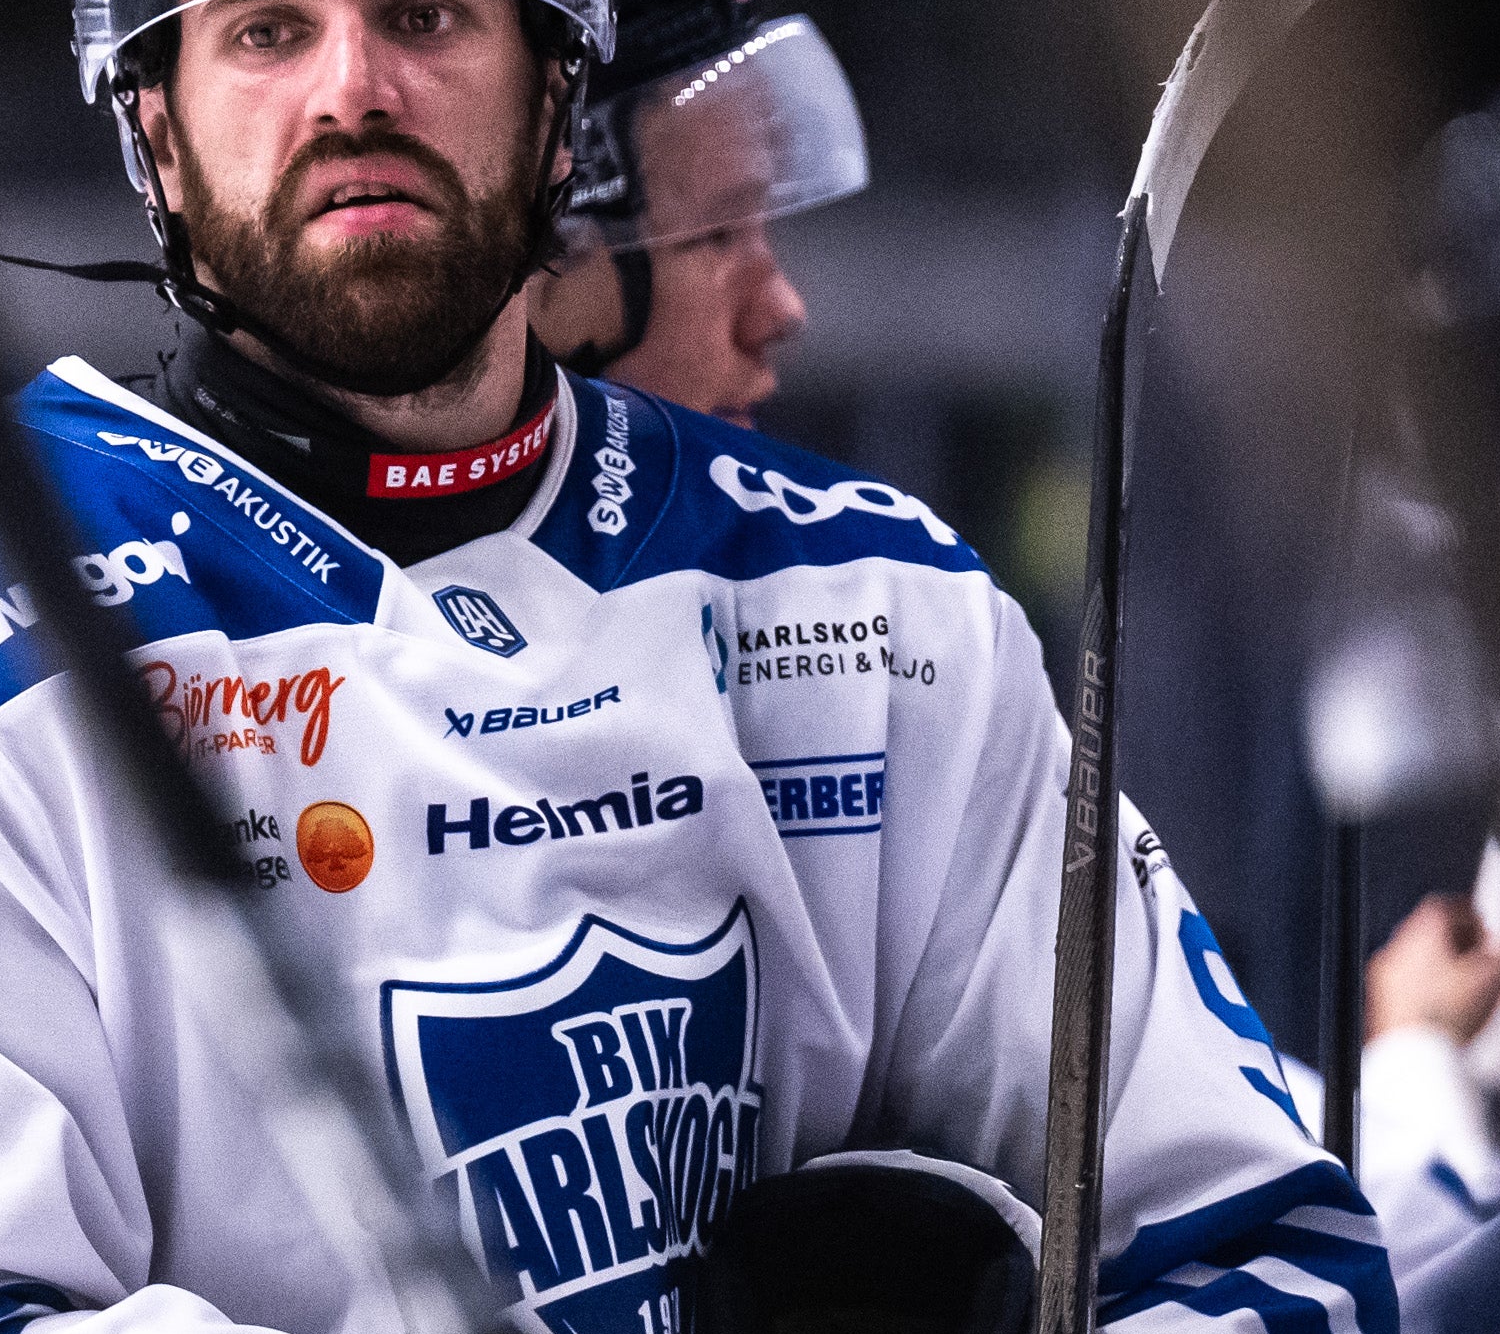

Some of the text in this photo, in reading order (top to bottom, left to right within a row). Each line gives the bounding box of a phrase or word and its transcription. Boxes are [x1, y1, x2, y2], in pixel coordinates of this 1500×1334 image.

[386, 463, 457, 488] BAE
[213, 477, 341, 584] AKUSTIK
[738, 652, 845, 685] ENERGI
[856, 652, 873, 673] &
[426, 771, 704, 856] Helmia
[555, 1001, 690, 1110] BIK
